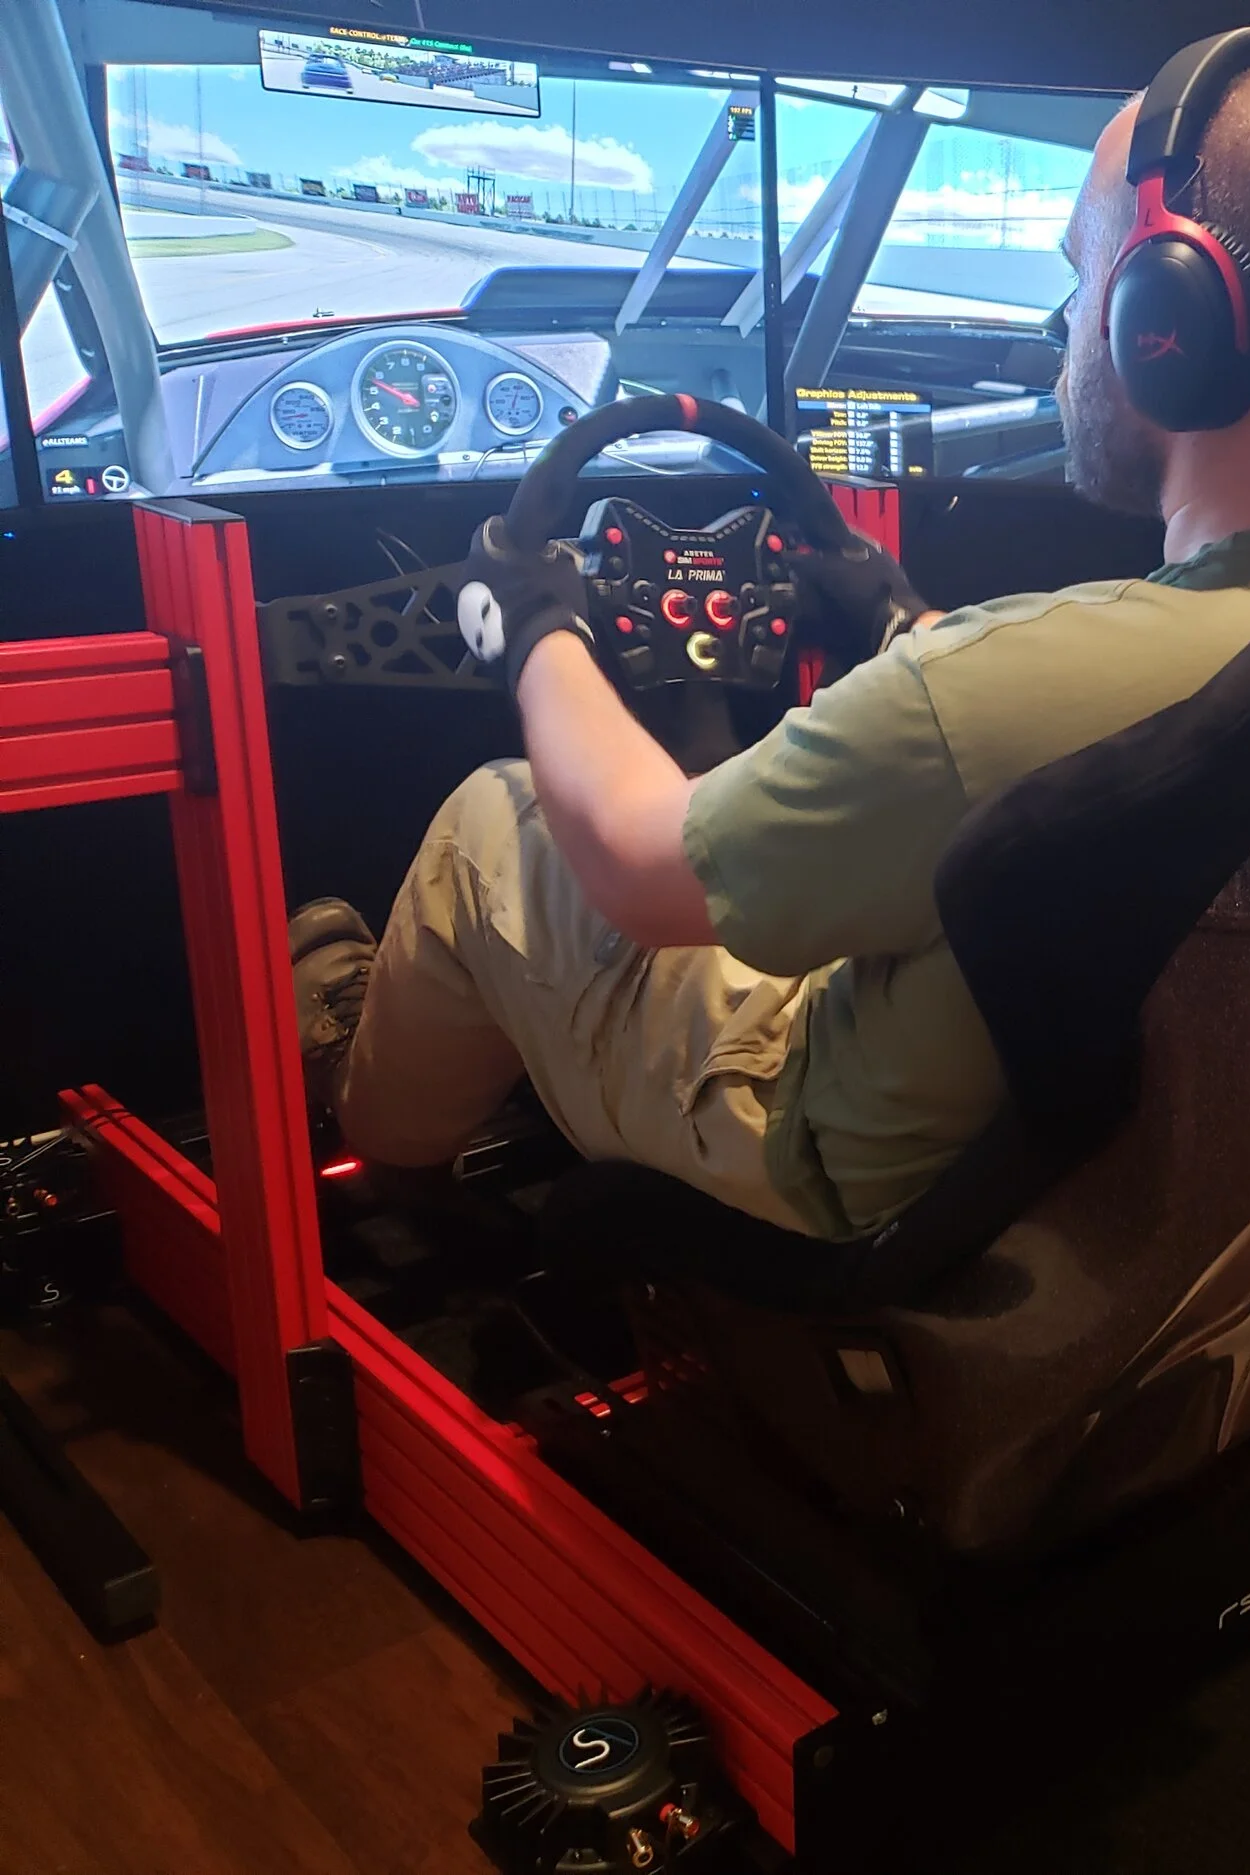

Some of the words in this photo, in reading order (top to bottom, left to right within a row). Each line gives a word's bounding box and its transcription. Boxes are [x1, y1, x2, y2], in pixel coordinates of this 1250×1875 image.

[1144, 207, 1155, 228] L
[796, 388, 846, 400] Graphics
[847, 389, 918, 401] Adjustments
[55, 469, 74, 484] 4
[667, 569, 684, 580] LA
[688, 569, 724, 582] PRIMA
